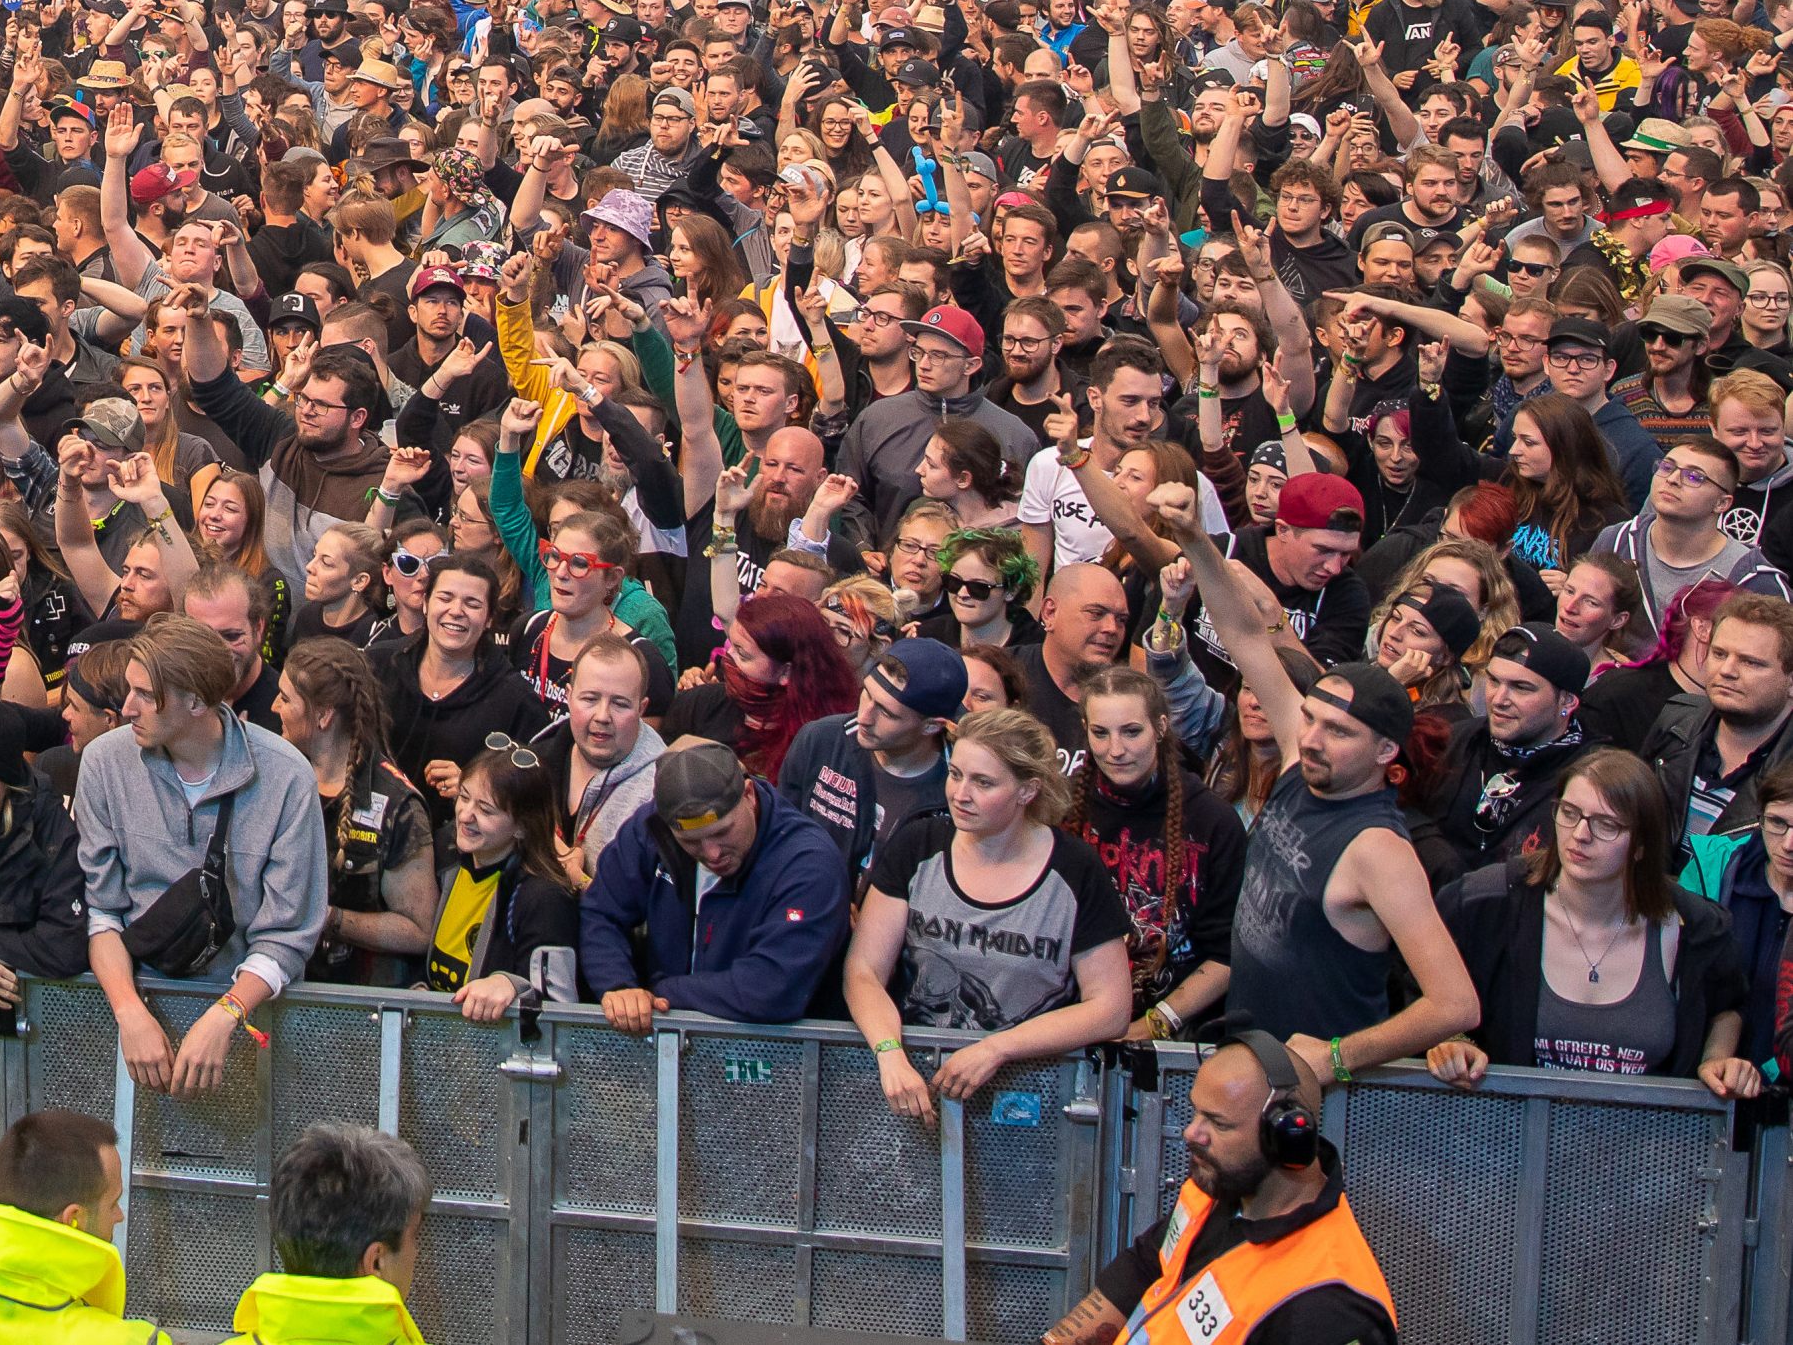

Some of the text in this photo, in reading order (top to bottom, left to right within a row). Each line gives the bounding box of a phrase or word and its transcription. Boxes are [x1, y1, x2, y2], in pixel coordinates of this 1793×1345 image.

[1405, 22, 1432, 40] VAN
[1053, 499, 1088, 522] RISE
[819, 766, 857, 798] MOUN
[909, 908, 1063, 966] RON MAIDEN
[1555, 1040, 1609, 1056] GFREITS
[1617, 1048, 1644, 1061] NED
[1559, 1054, 1590, 1066] TUAT
[1595, 1058, 1614, 1072] OIS
[1620, 1060, 1646, 1074] WEH
[1189, 1290, 1218, 1336] 333
